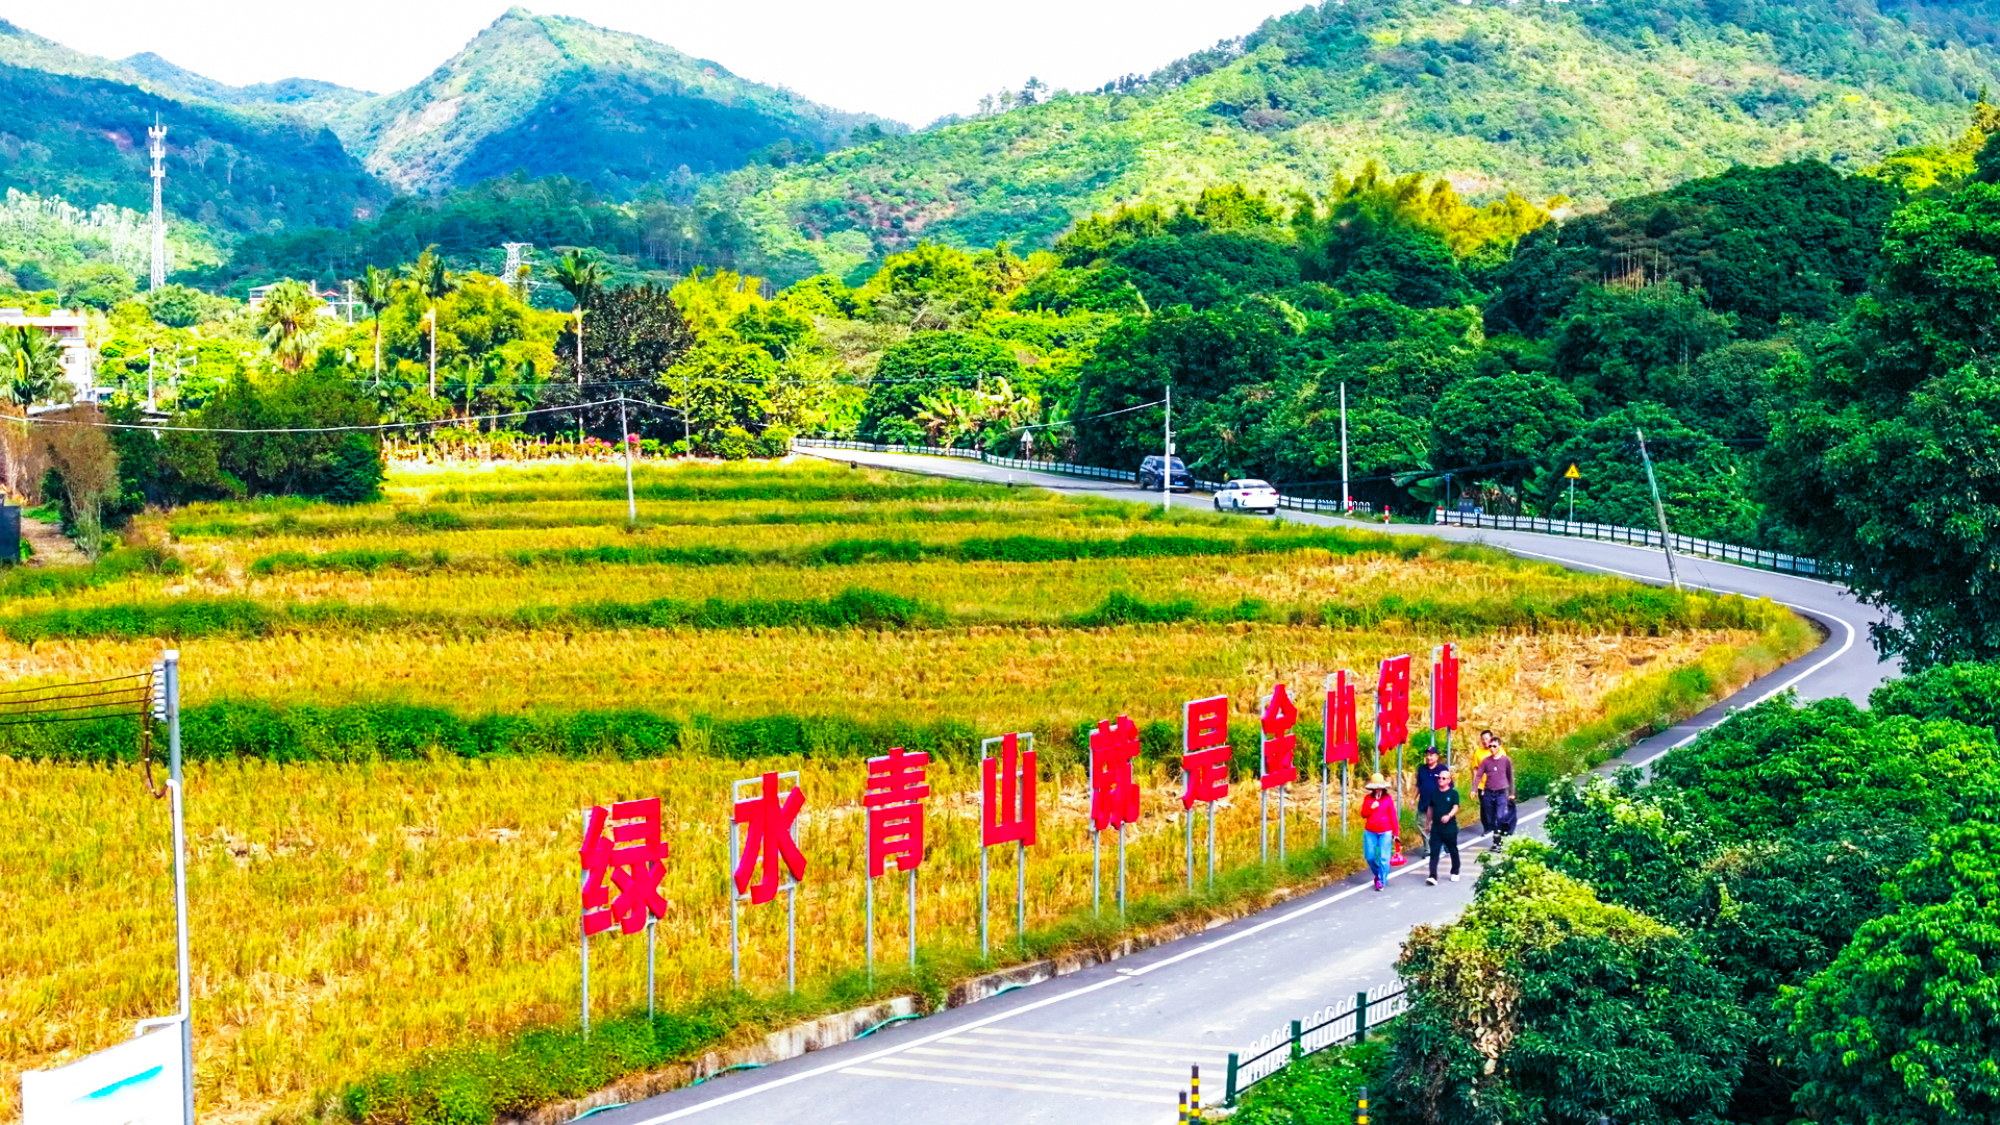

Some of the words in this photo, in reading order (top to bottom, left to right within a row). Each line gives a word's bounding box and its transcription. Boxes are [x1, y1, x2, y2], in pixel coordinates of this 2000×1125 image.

[580, 643, 1458, 935] 绿水青山就是金山银山
